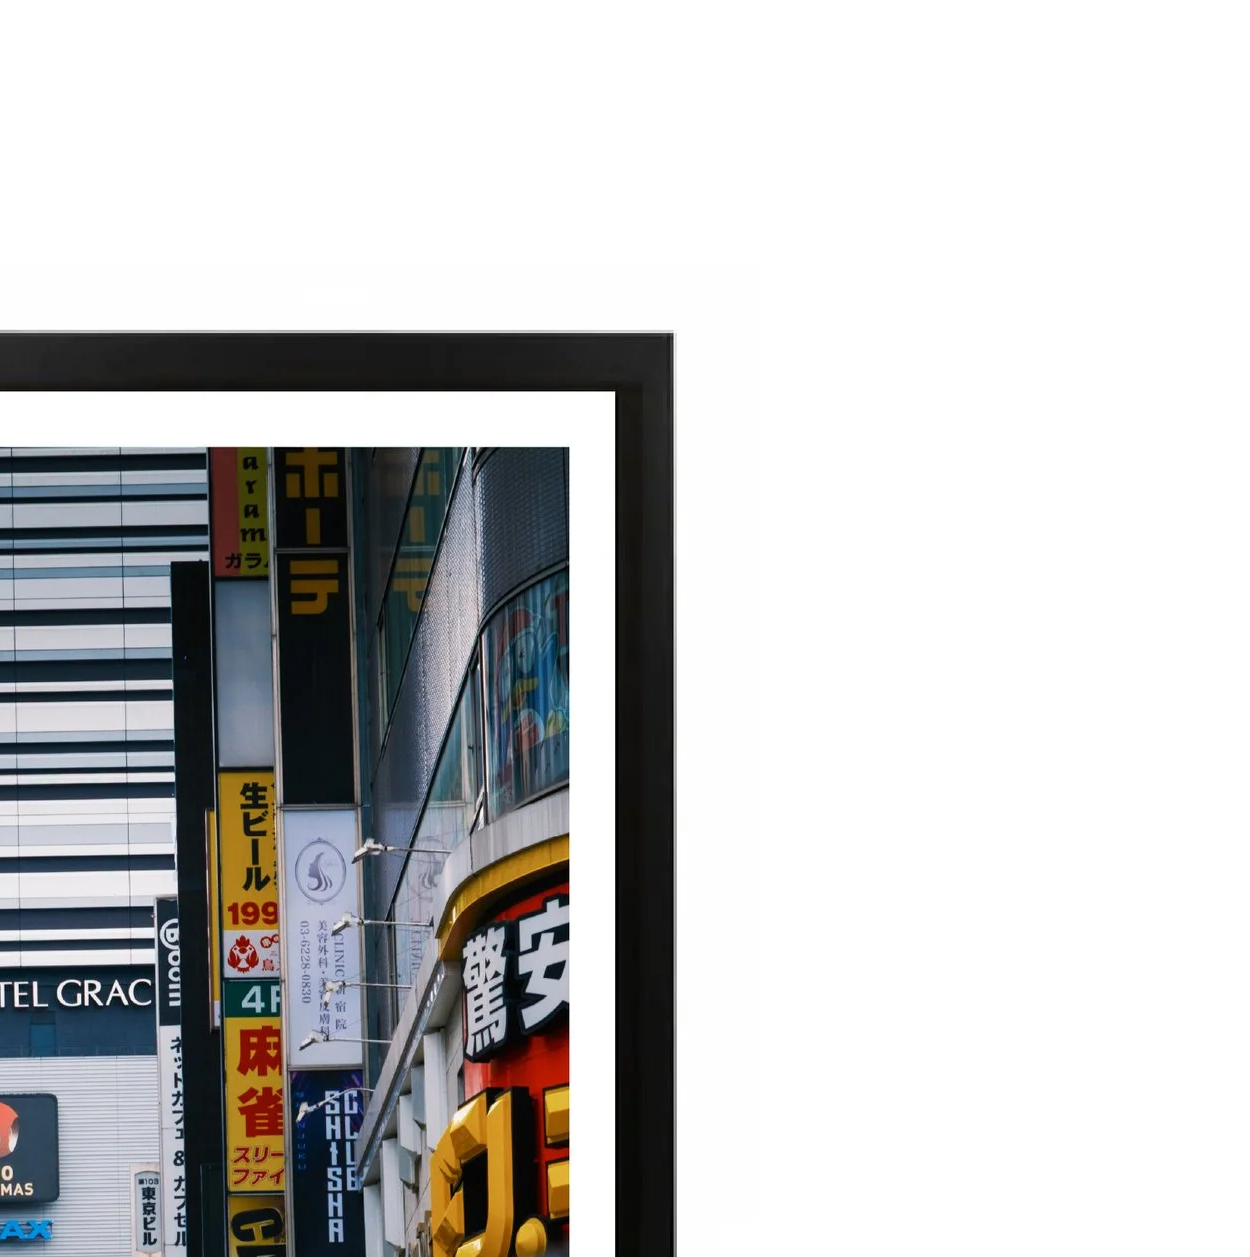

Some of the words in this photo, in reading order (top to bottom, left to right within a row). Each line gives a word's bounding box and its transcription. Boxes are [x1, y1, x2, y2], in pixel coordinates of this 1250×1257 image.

[225, 552, 268, 569] ガラ
[240, 782, 271, 891] 生ビール
[56, 979, 152, 1007] GRAC
[237, 1025, 284, 1138] 麻雀
[142, 1186, 157, 1246] 東京ビル
